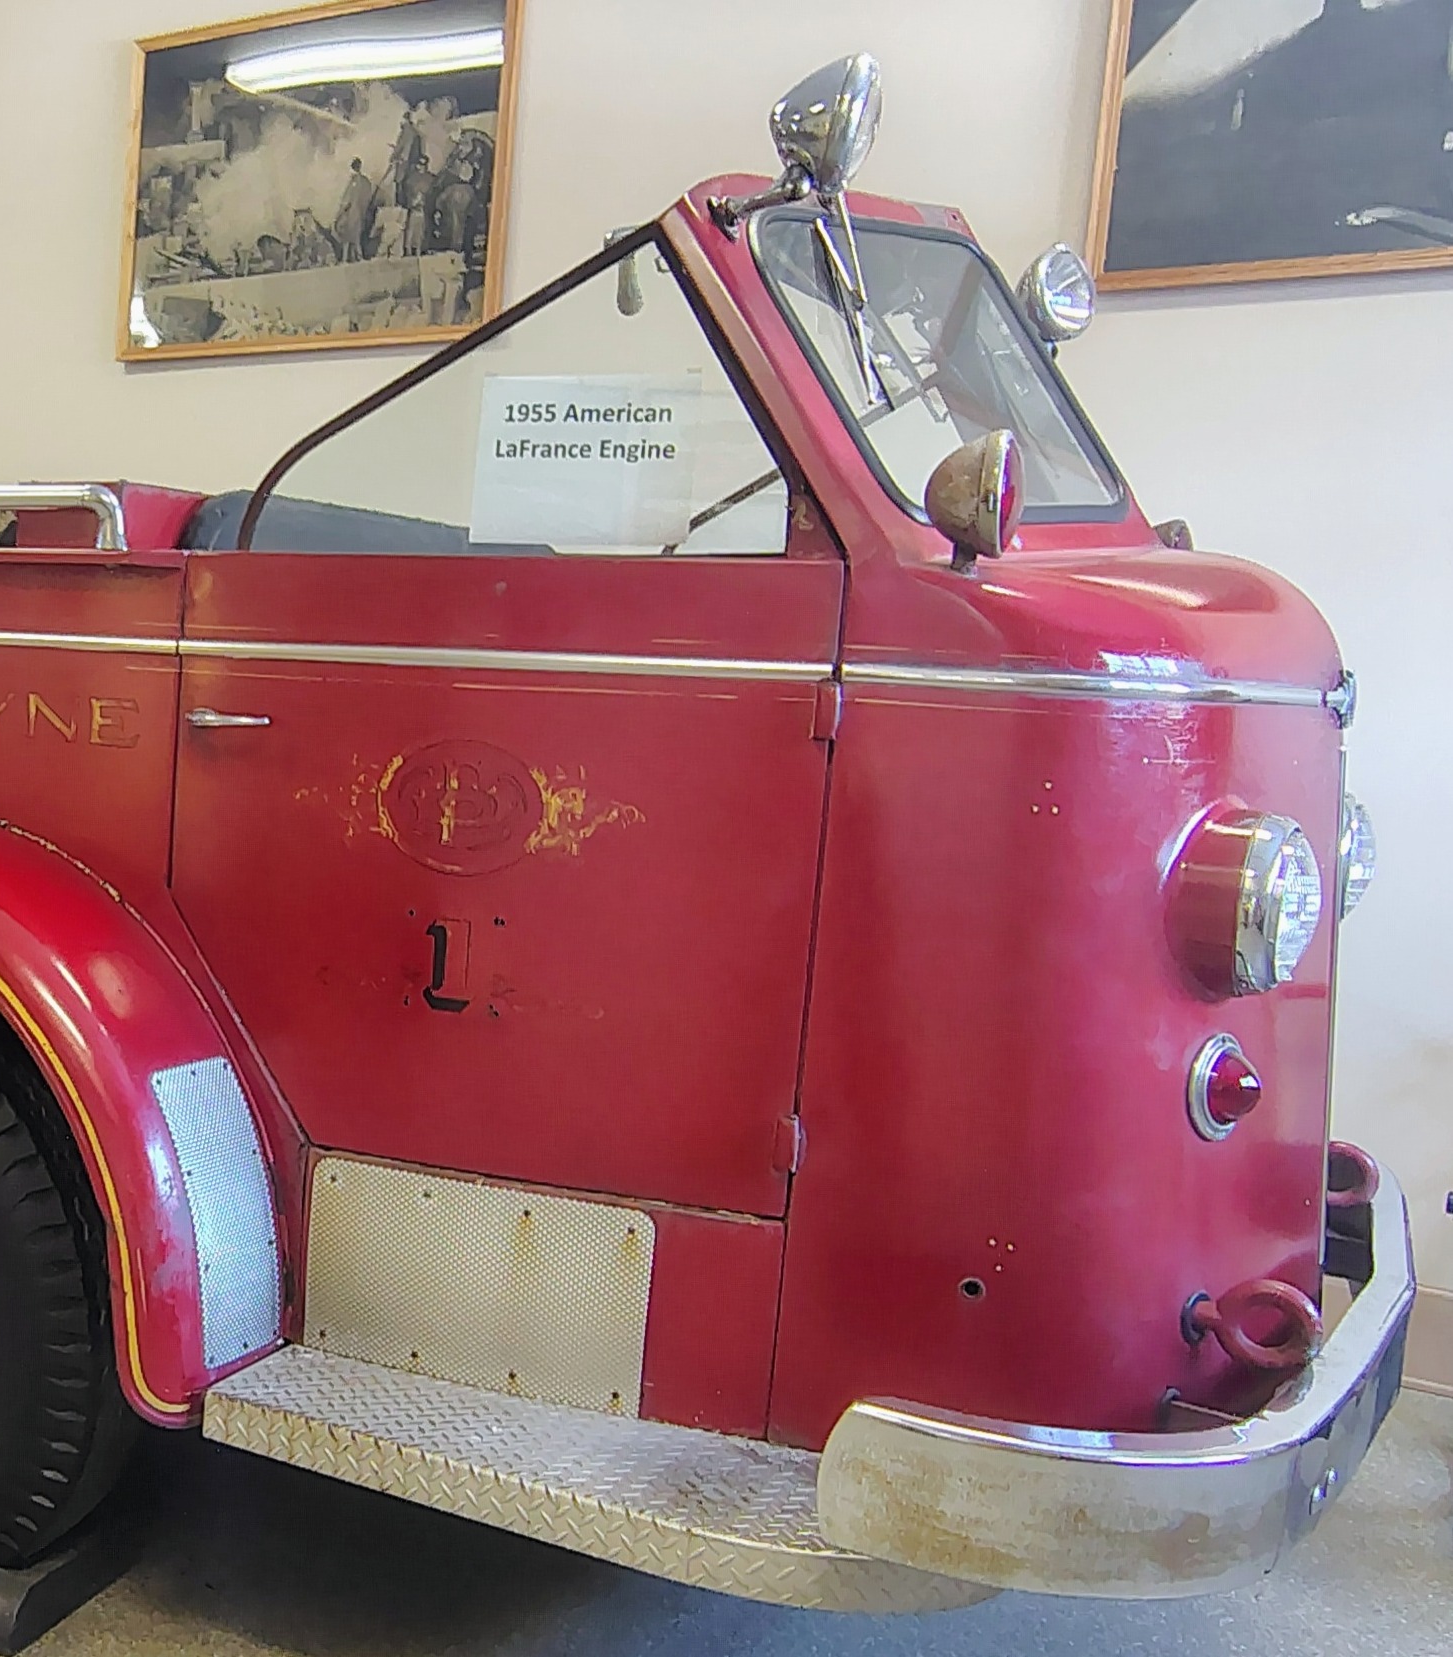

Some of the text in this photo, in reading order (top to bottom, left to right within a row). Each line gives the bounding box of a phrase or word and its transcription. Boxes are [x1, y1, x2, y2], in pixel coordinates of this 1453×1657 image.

[504, 402, 673, 422] 1955 American
[495, 438, 676, 463] LaFrance Engine
